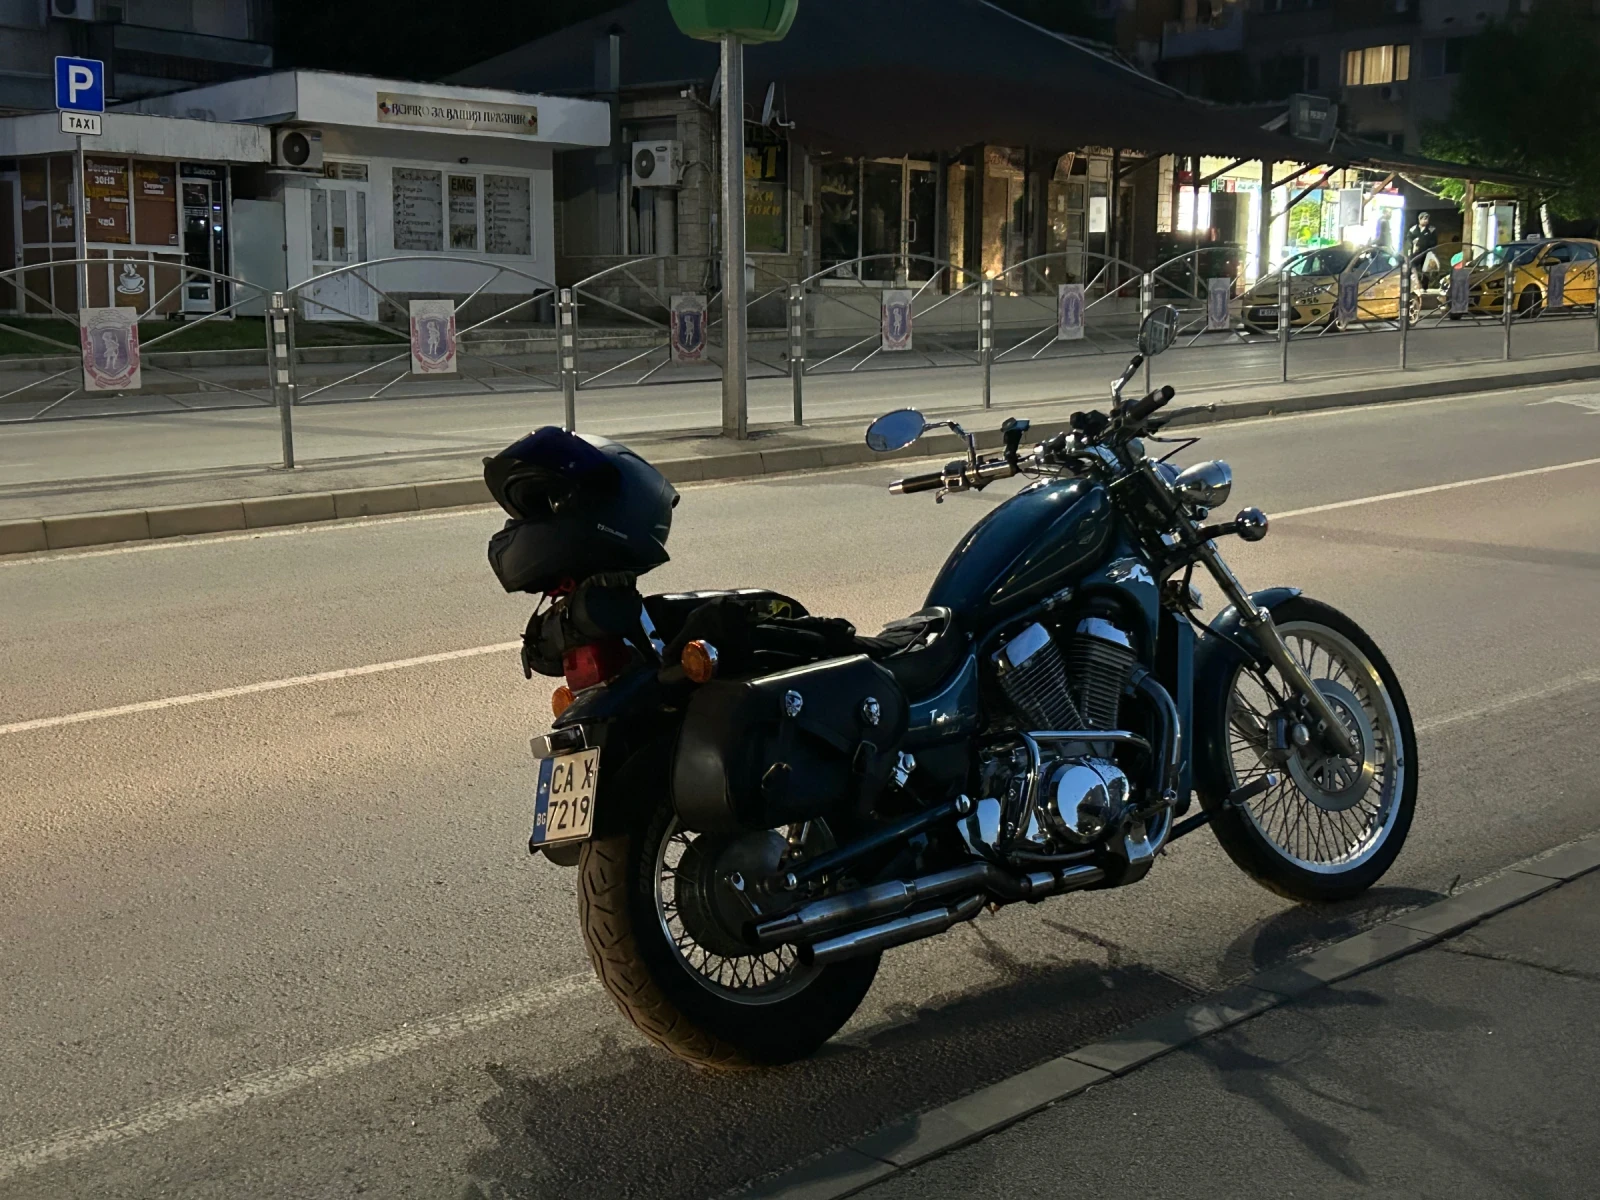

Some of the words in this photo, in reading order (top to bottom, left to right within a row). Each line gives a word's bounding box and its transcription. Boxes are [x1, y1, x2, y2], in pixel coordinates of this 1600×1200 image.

[68, 64, 94, 104] P
[391, 103, 430, 117] ВСИЧКО
[431, 107, 445, 118] ЗА
[446, 108, 481, 122] ВАШИЯ
[69, 117, 95, 130] TAXI
[451, 177, 474, 192] EMG
[552, 761, 574, 794] CA
[581, 758, 594, 790] X
[536, 812, 547, 826] BG
[547, 795, 590, 832] 7219
